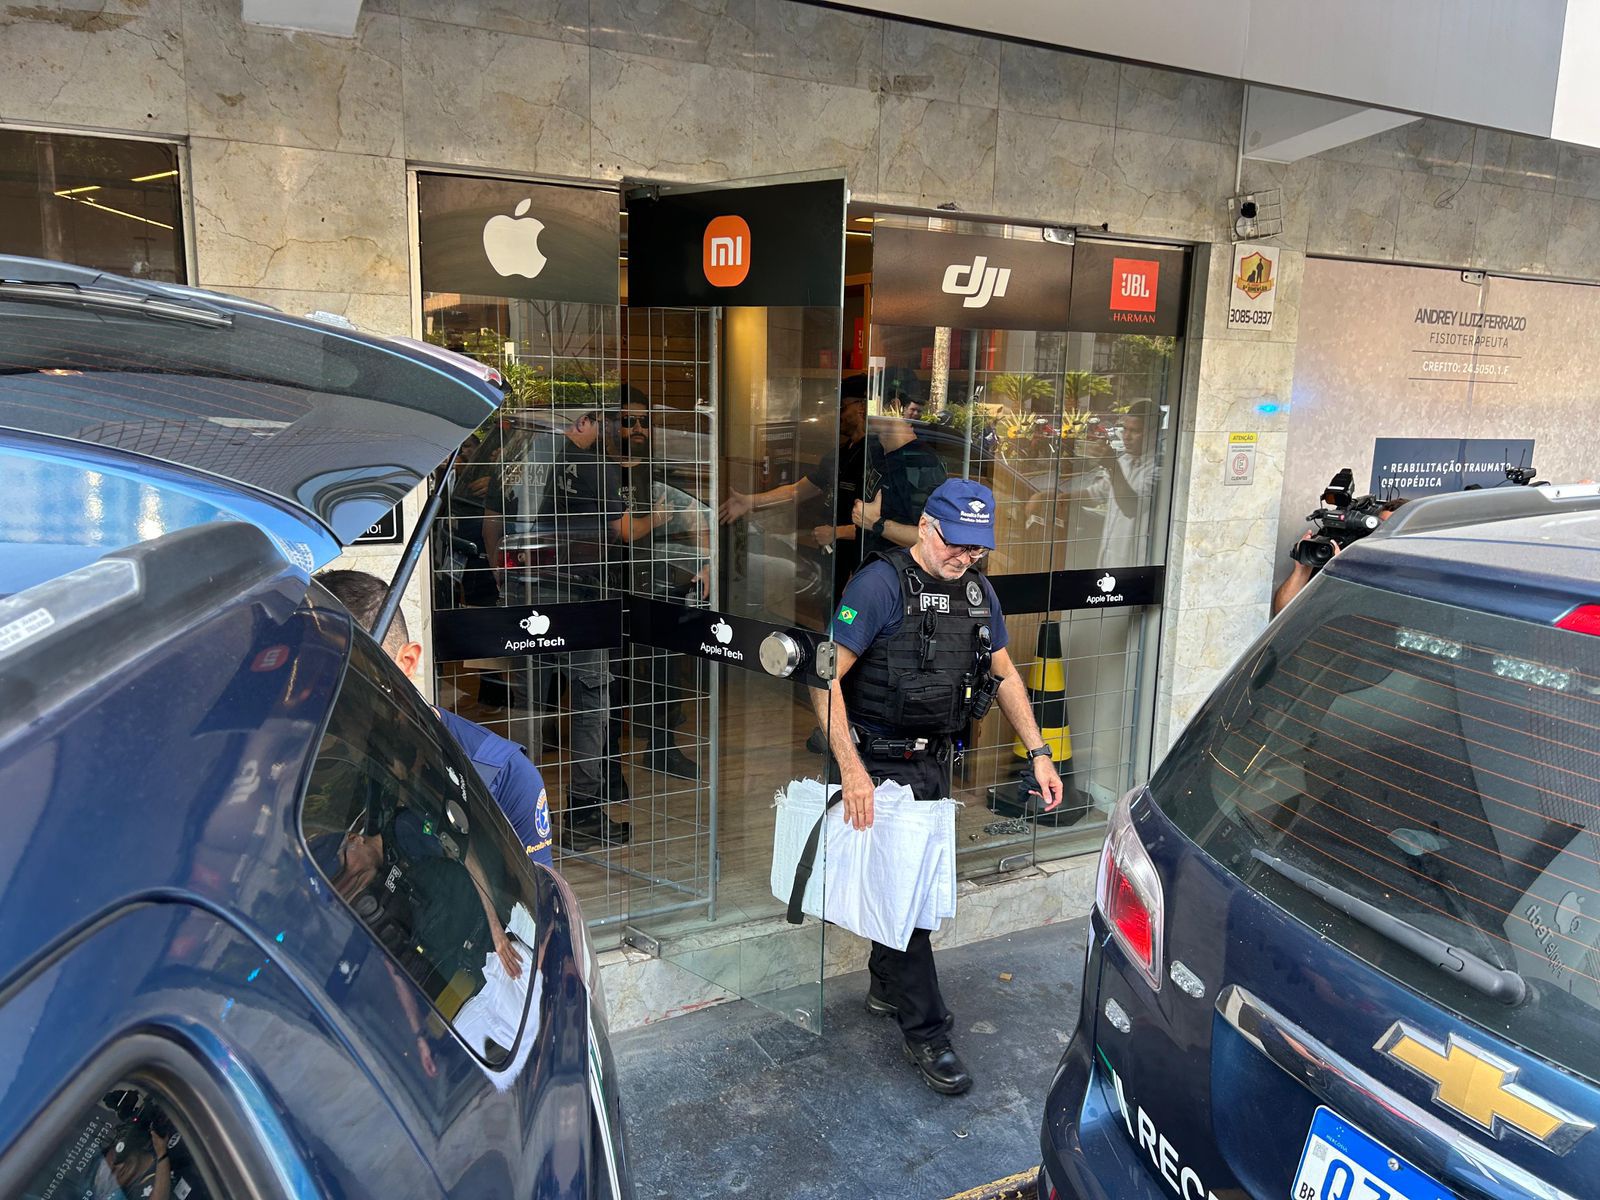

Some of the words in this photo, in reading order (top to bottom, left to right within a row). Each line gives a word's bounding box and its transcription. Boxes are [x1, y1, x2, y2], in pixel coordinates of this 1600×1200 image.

[1113, 312, 1156, 324] HARMAN
[1230, 308, 1272, 325] 3085-0337
[1414, 308, 1458, 326] ANDREY
[1458, 312, 1484, 328] LUIZ
[1483, 314, 1527, 332] FERRAZO
[1429, 332, 1509, 348] FISIOTERAPEUTA
[1422, 360, 1461, 374] CREFITO:
[1390, 460, 1462, 475] REABILITAÇÃO
[1381, 475, 1443, 488] ORTOPÉDICA
[922, 595, 948, 610] RFB
[1086, 595, 1105, 604] Apple
[1106, 594, 1124, 602] Tech
[504, 639, 536, 651] Apple
[536, 636, 565, 648] Tech
[700, 642, 722, 655] Apple
[722, 647, 744, 661] Tech
[1326, 1134, 1349, 1153] MERCOSUL
[1138, 1105, 1219, 1200] REC
[1299, 1182, 1316, 1200] BR
